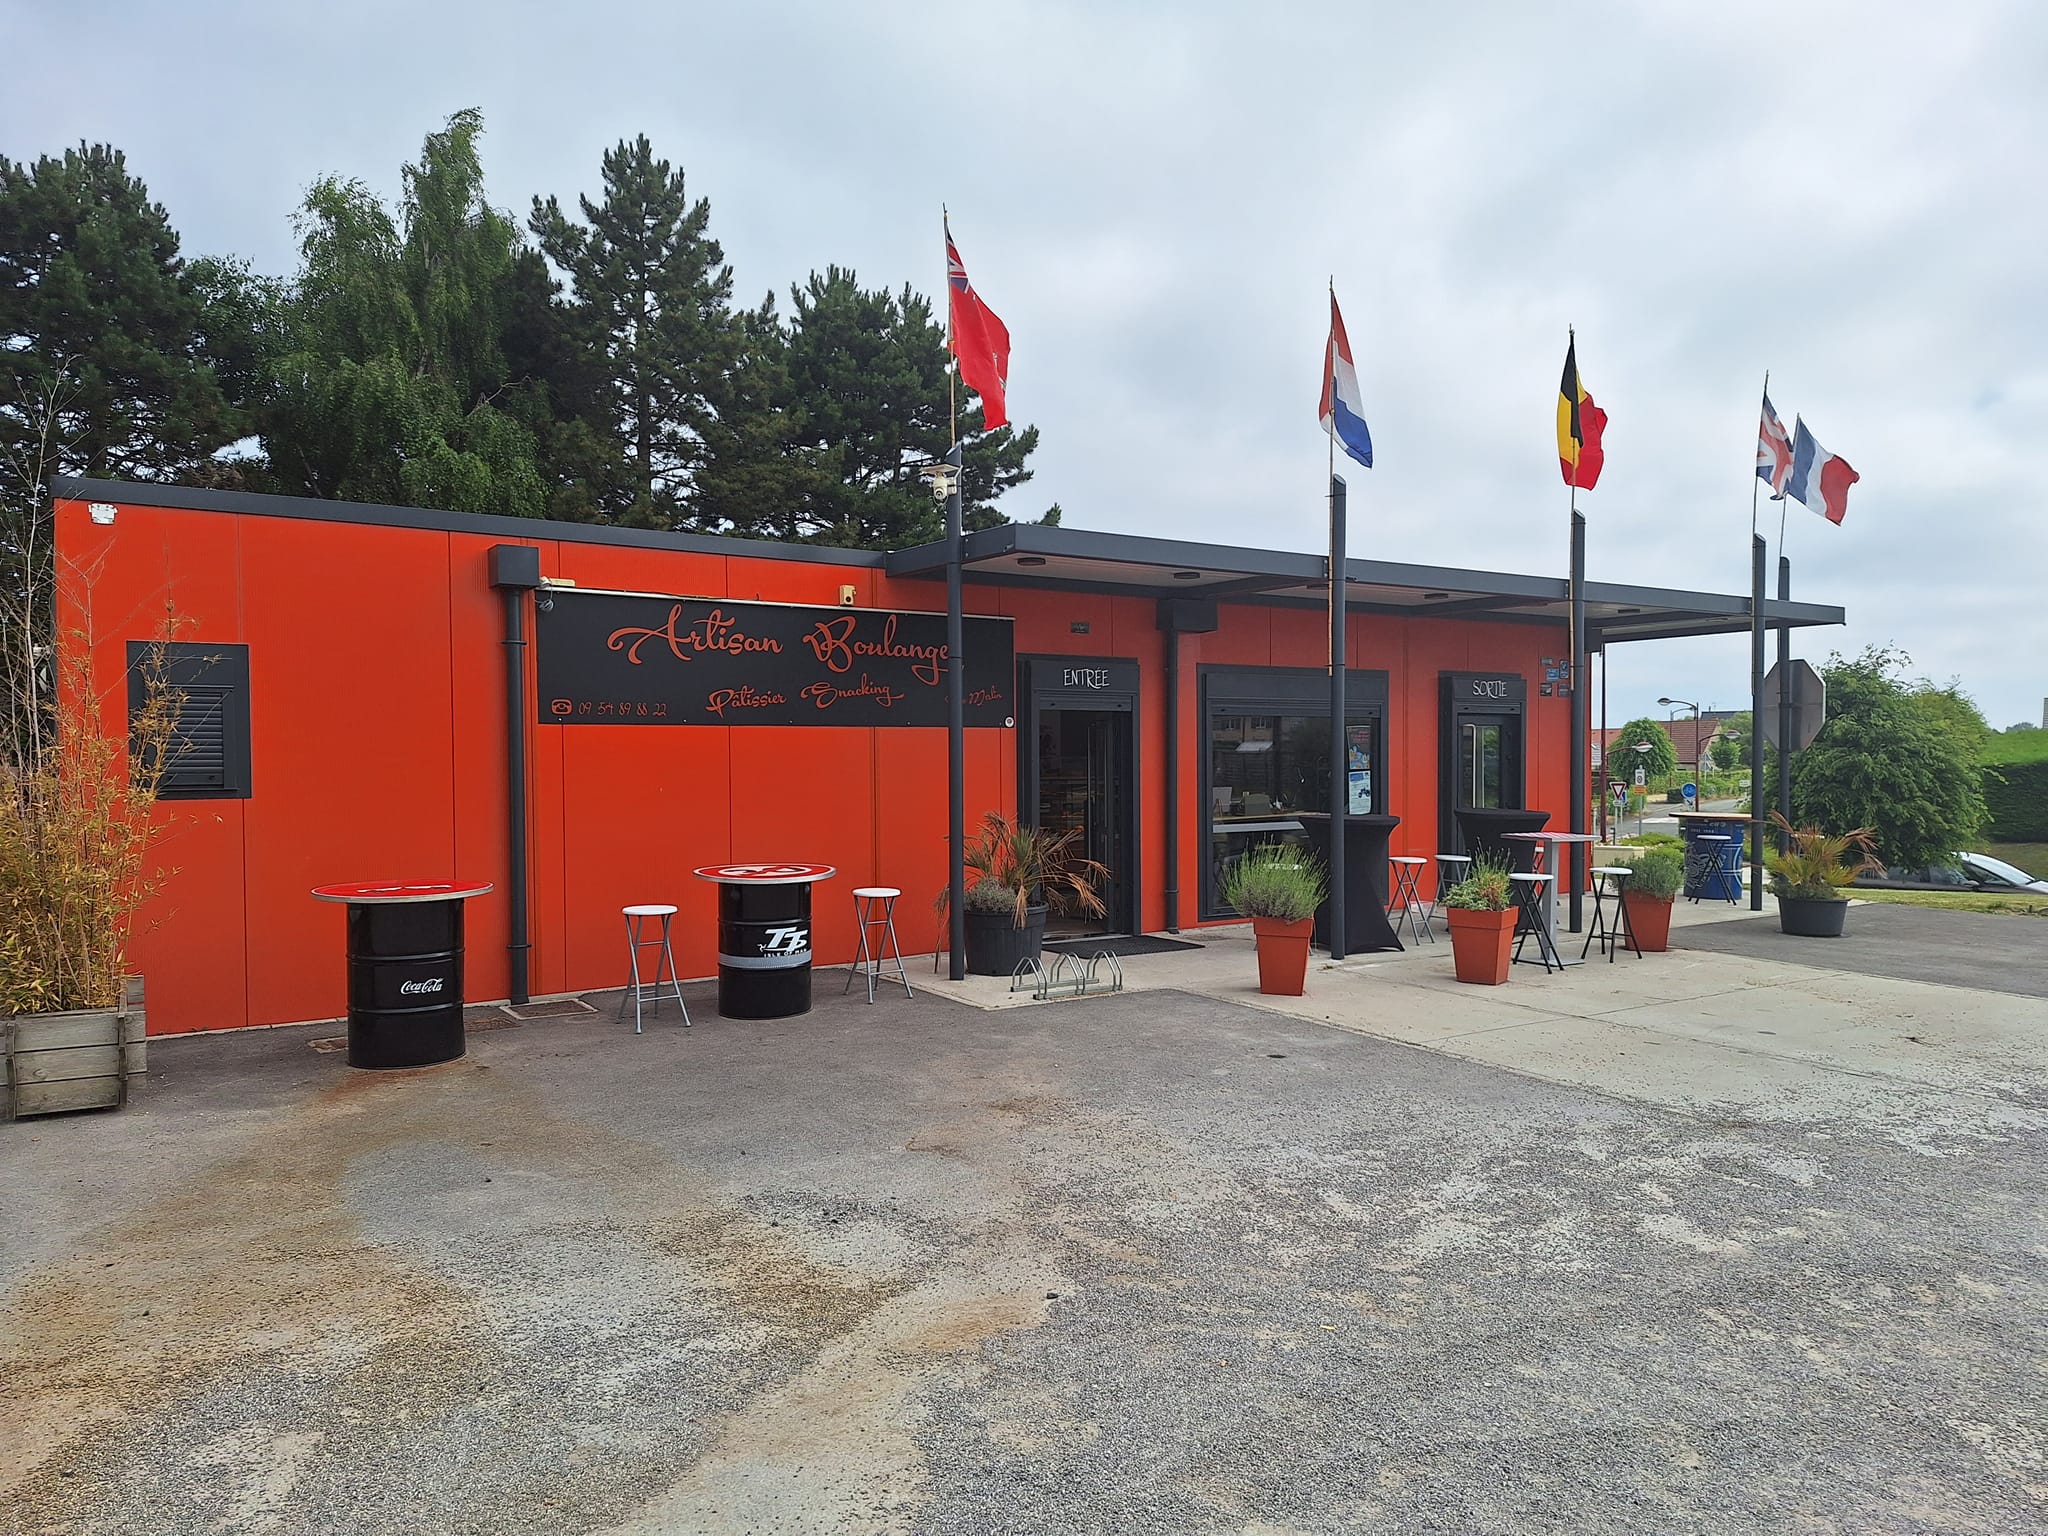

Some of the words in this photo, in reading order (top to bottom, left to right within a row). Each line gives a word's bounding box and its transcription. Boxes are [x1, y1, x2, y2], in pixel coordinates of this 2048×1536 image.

[607, 603, 784, 665] Artisan
[802, 614, 951, 687] Boulange
[1063, 667, 1110, 689] ENTRÉE
[705, 685, 788, 719] Pâtissier
[801, 673, 905, 709] Snacking
[1472, 680, 1508, 699] SORTIE
[578, 701, 592, 716] 09
[597, 701, 614, 716] 54
[618, 702, 632, 716] 89
[636, 702, 648, 716] 88
[651, 703, 667, 717] 22
[400, 977, 444, 995] Coca-Cola
